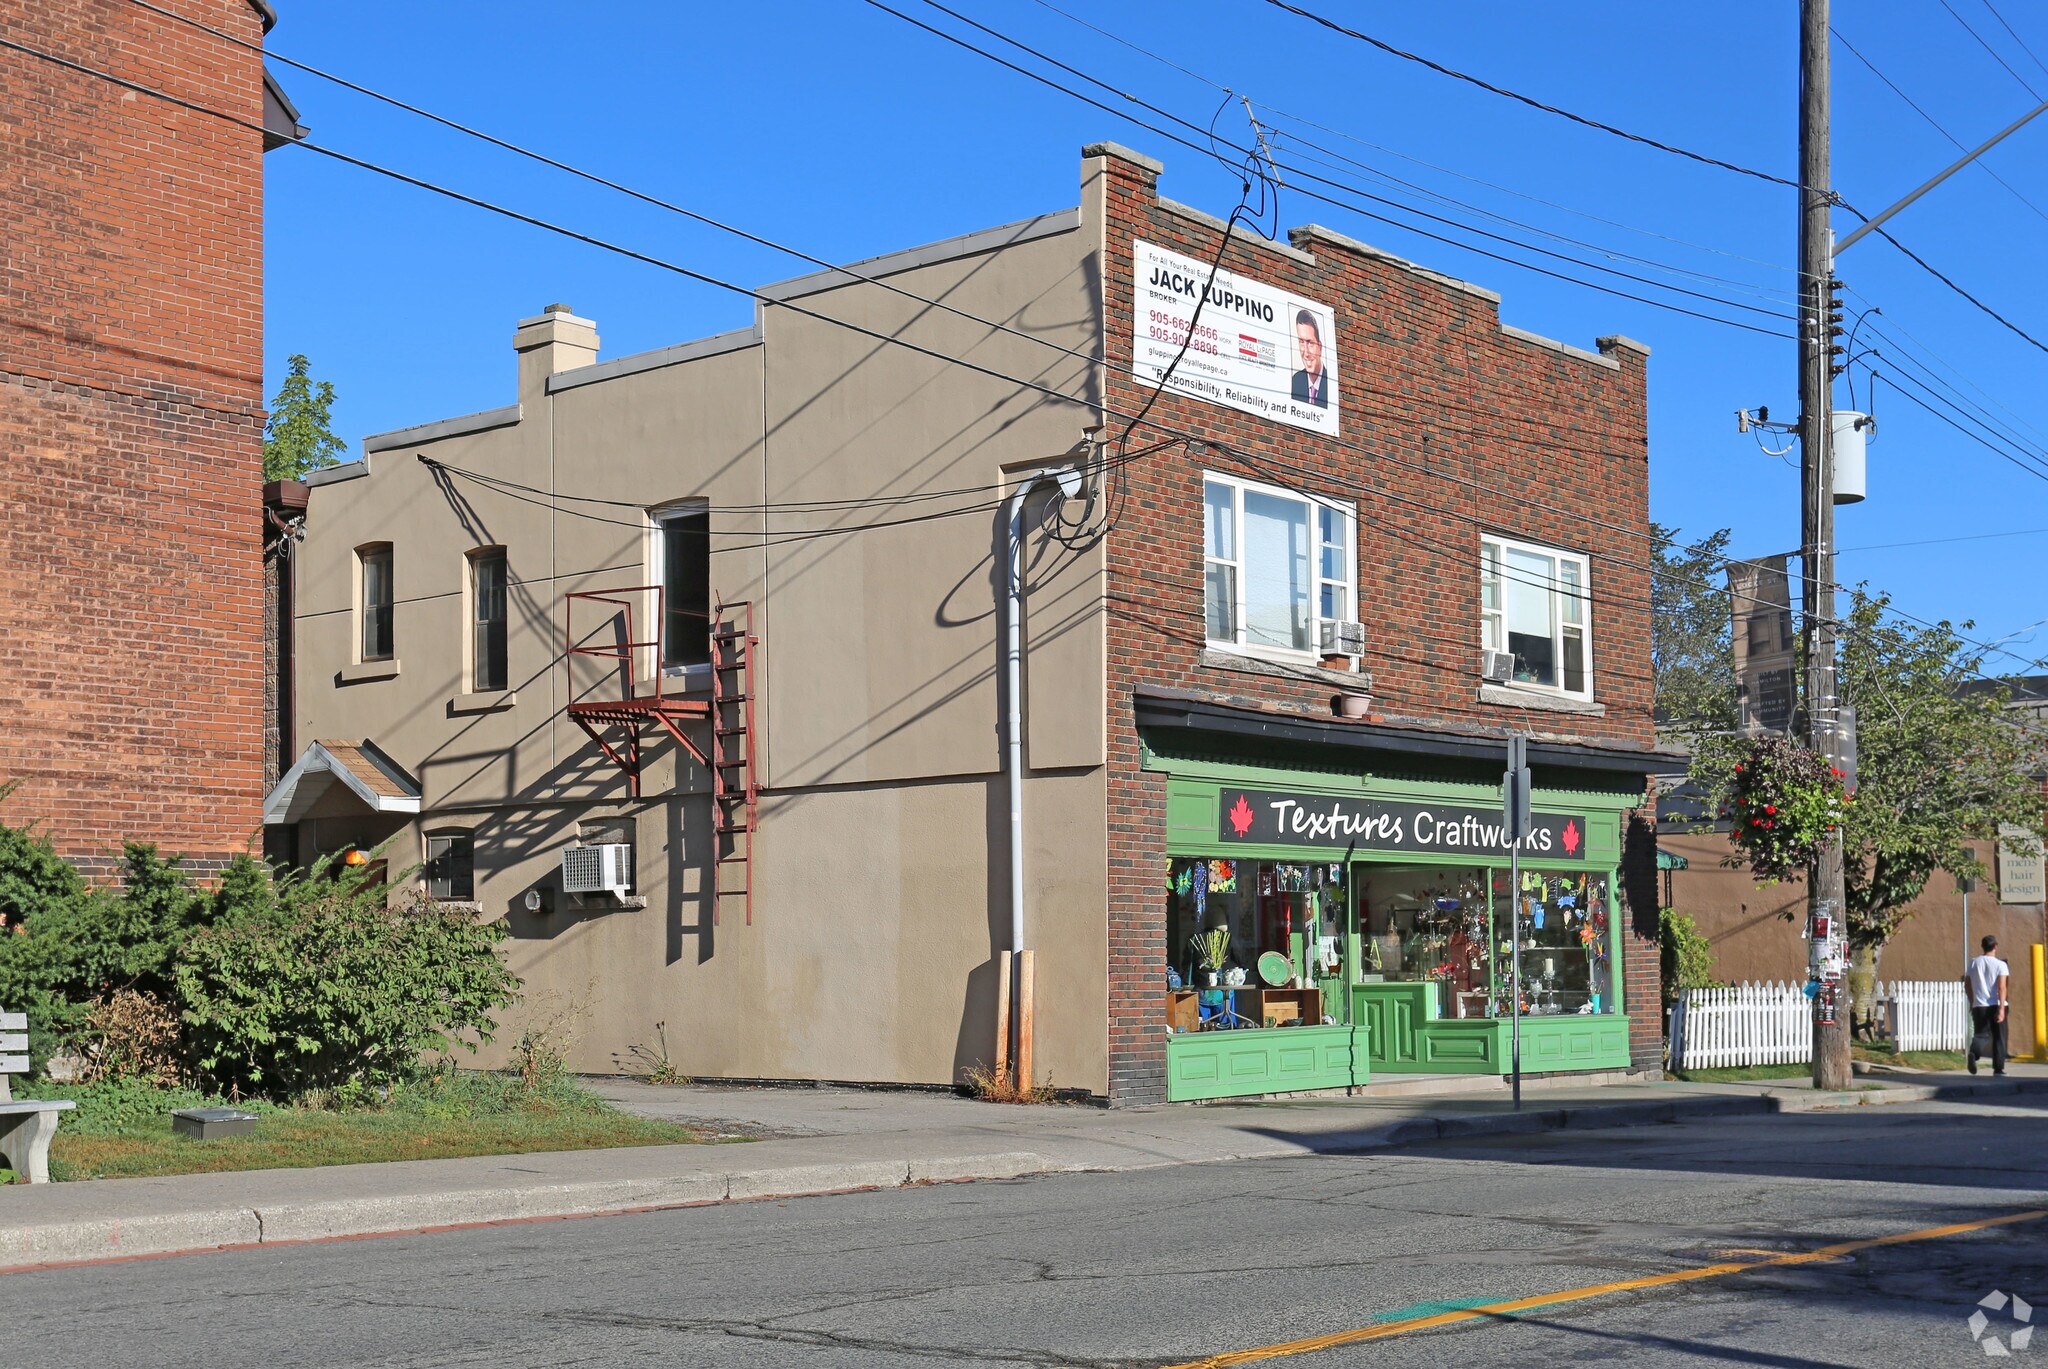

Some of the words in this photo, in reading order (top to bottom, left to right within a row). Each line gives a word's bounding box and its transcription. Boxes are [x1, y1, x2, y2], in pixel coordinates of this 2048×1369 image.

[1149, 253, 1158, 263] For
[1160, 257, 1168, 266] All
[1169, 260, 1182, 271] Your
[1183, 265, 1196, 276] Real
[1197, 270, 1213, 281] Esta
[1149, 290, 1177, 305] BROKER
[1150, 267, 1196, 298] JACK
[1201, 283, 1273, 323] LUPPINO
[1150, 310, 1218, 341] 905-6626666
[1238, 340, 1256, 352] ROYAL
[1149, 347, 1228, 376] gluppinoroyallepage.ca
[1226, 388, 1268, 411] Reliability
[1271, 402, 1287, 414] and
[1270, 800, 1403, 844] Textures
[2010, 870, 2035, 880] hair
[2004, 884, 2041, 896] design
